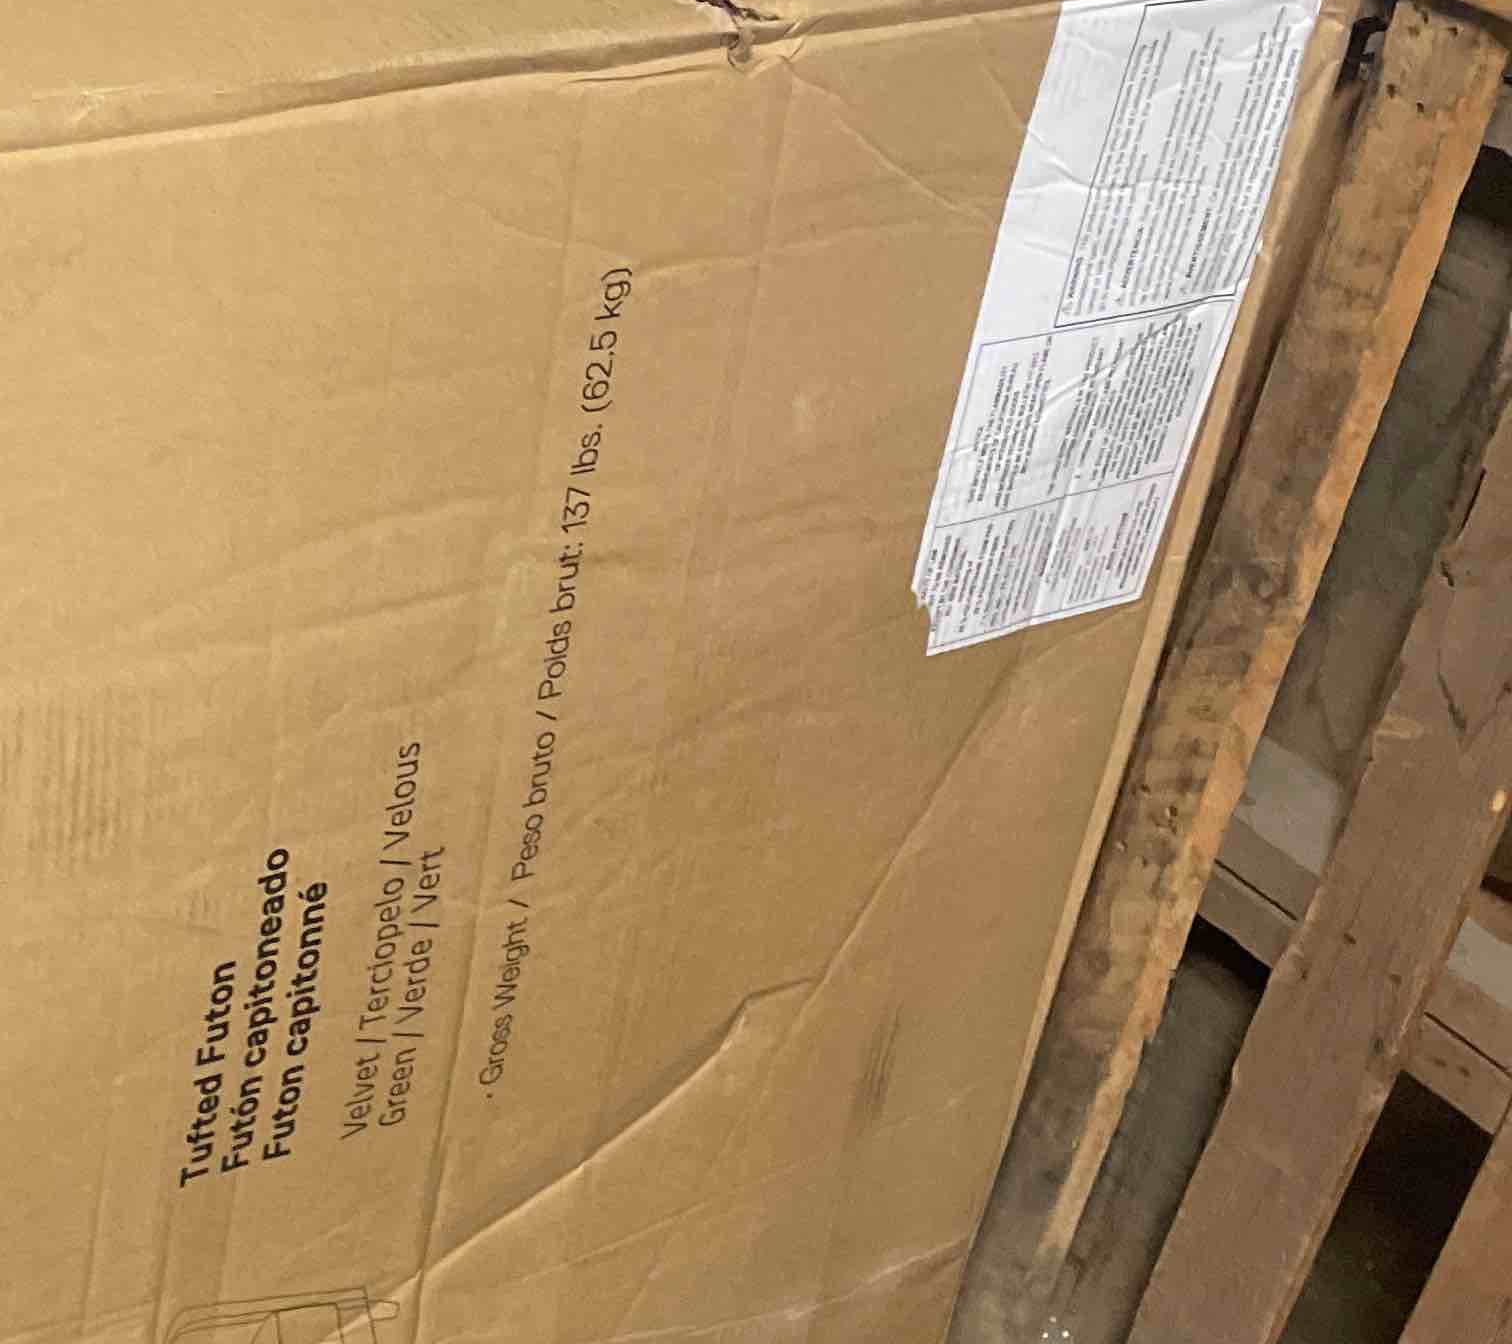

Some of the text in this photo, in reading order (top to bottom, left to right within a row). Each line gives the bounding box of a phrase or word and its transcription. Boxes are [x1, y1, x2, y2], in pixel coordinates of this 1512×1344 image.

[594, 267, 632, 320] kg)
[581, 330, 618, 412] (62.5
[570, 423, 603, 476] lbs.
[561, 487, 591, 533] 137
[547, 543, 584, 610] brut:
[537, 620, 573, 700] Poids
[381, 742, 422, 851] Velous
[522, 731, 555, 807] bruto
[409, 846, 446, 913] Vert
[511, 814, 545, 881] Peso
[357, 878, 405, 1031] Terciopelo
[394, 938, 432, 1024] Verde
[492, 918, 530, 1010] Weight
[221, 847, 289, 1173] Futón capitoneado
[262, 881, 328, 1160] Futon capitonné
[479, 1014, 513, 1085] Gross
[180, 961, 236, 1188] Tufted Futon
[340, 1052, 381, 1139] Velvet
[378, 1047, 416, 1127] Green
